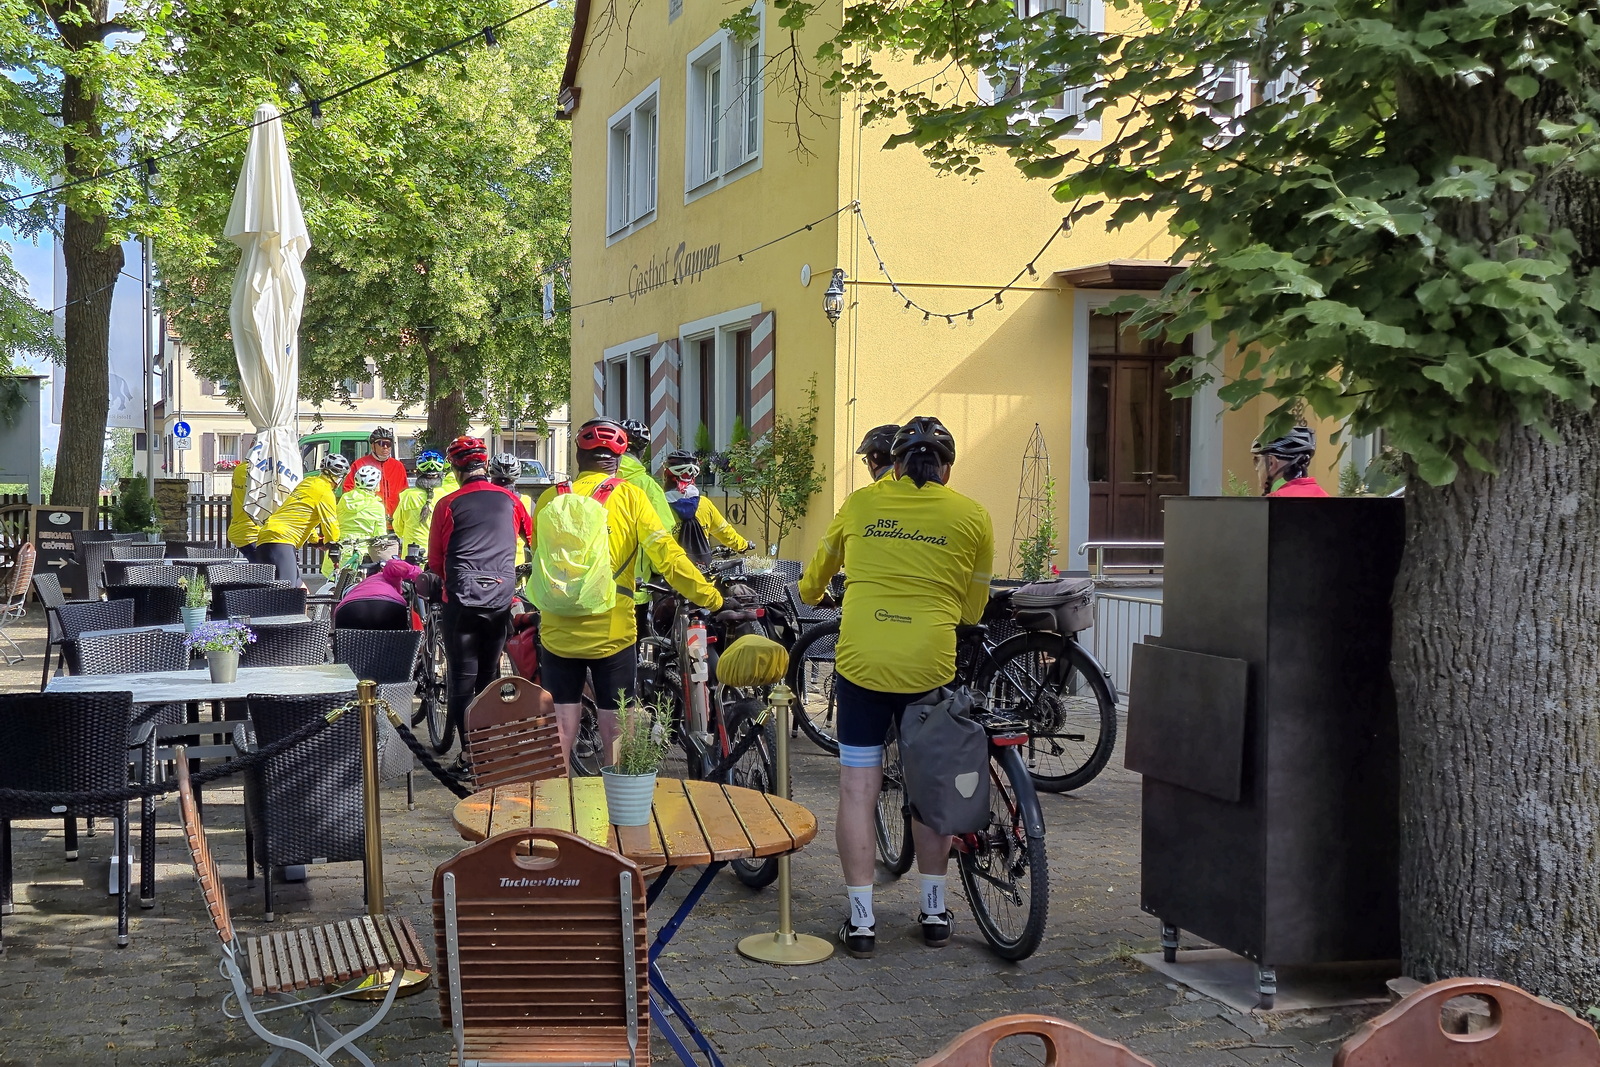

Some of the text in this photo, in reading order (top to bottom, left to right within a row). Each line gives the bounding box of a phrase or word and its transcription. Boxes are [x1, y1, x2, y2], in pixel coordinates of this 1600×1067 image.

[628, 241, 720, 306] Gasthof Rappen
[877, 519, 899, 529] RSF
[863, 524, 948, 546] Bartholomä
[499, 877, 580, 888] TucherBräu
